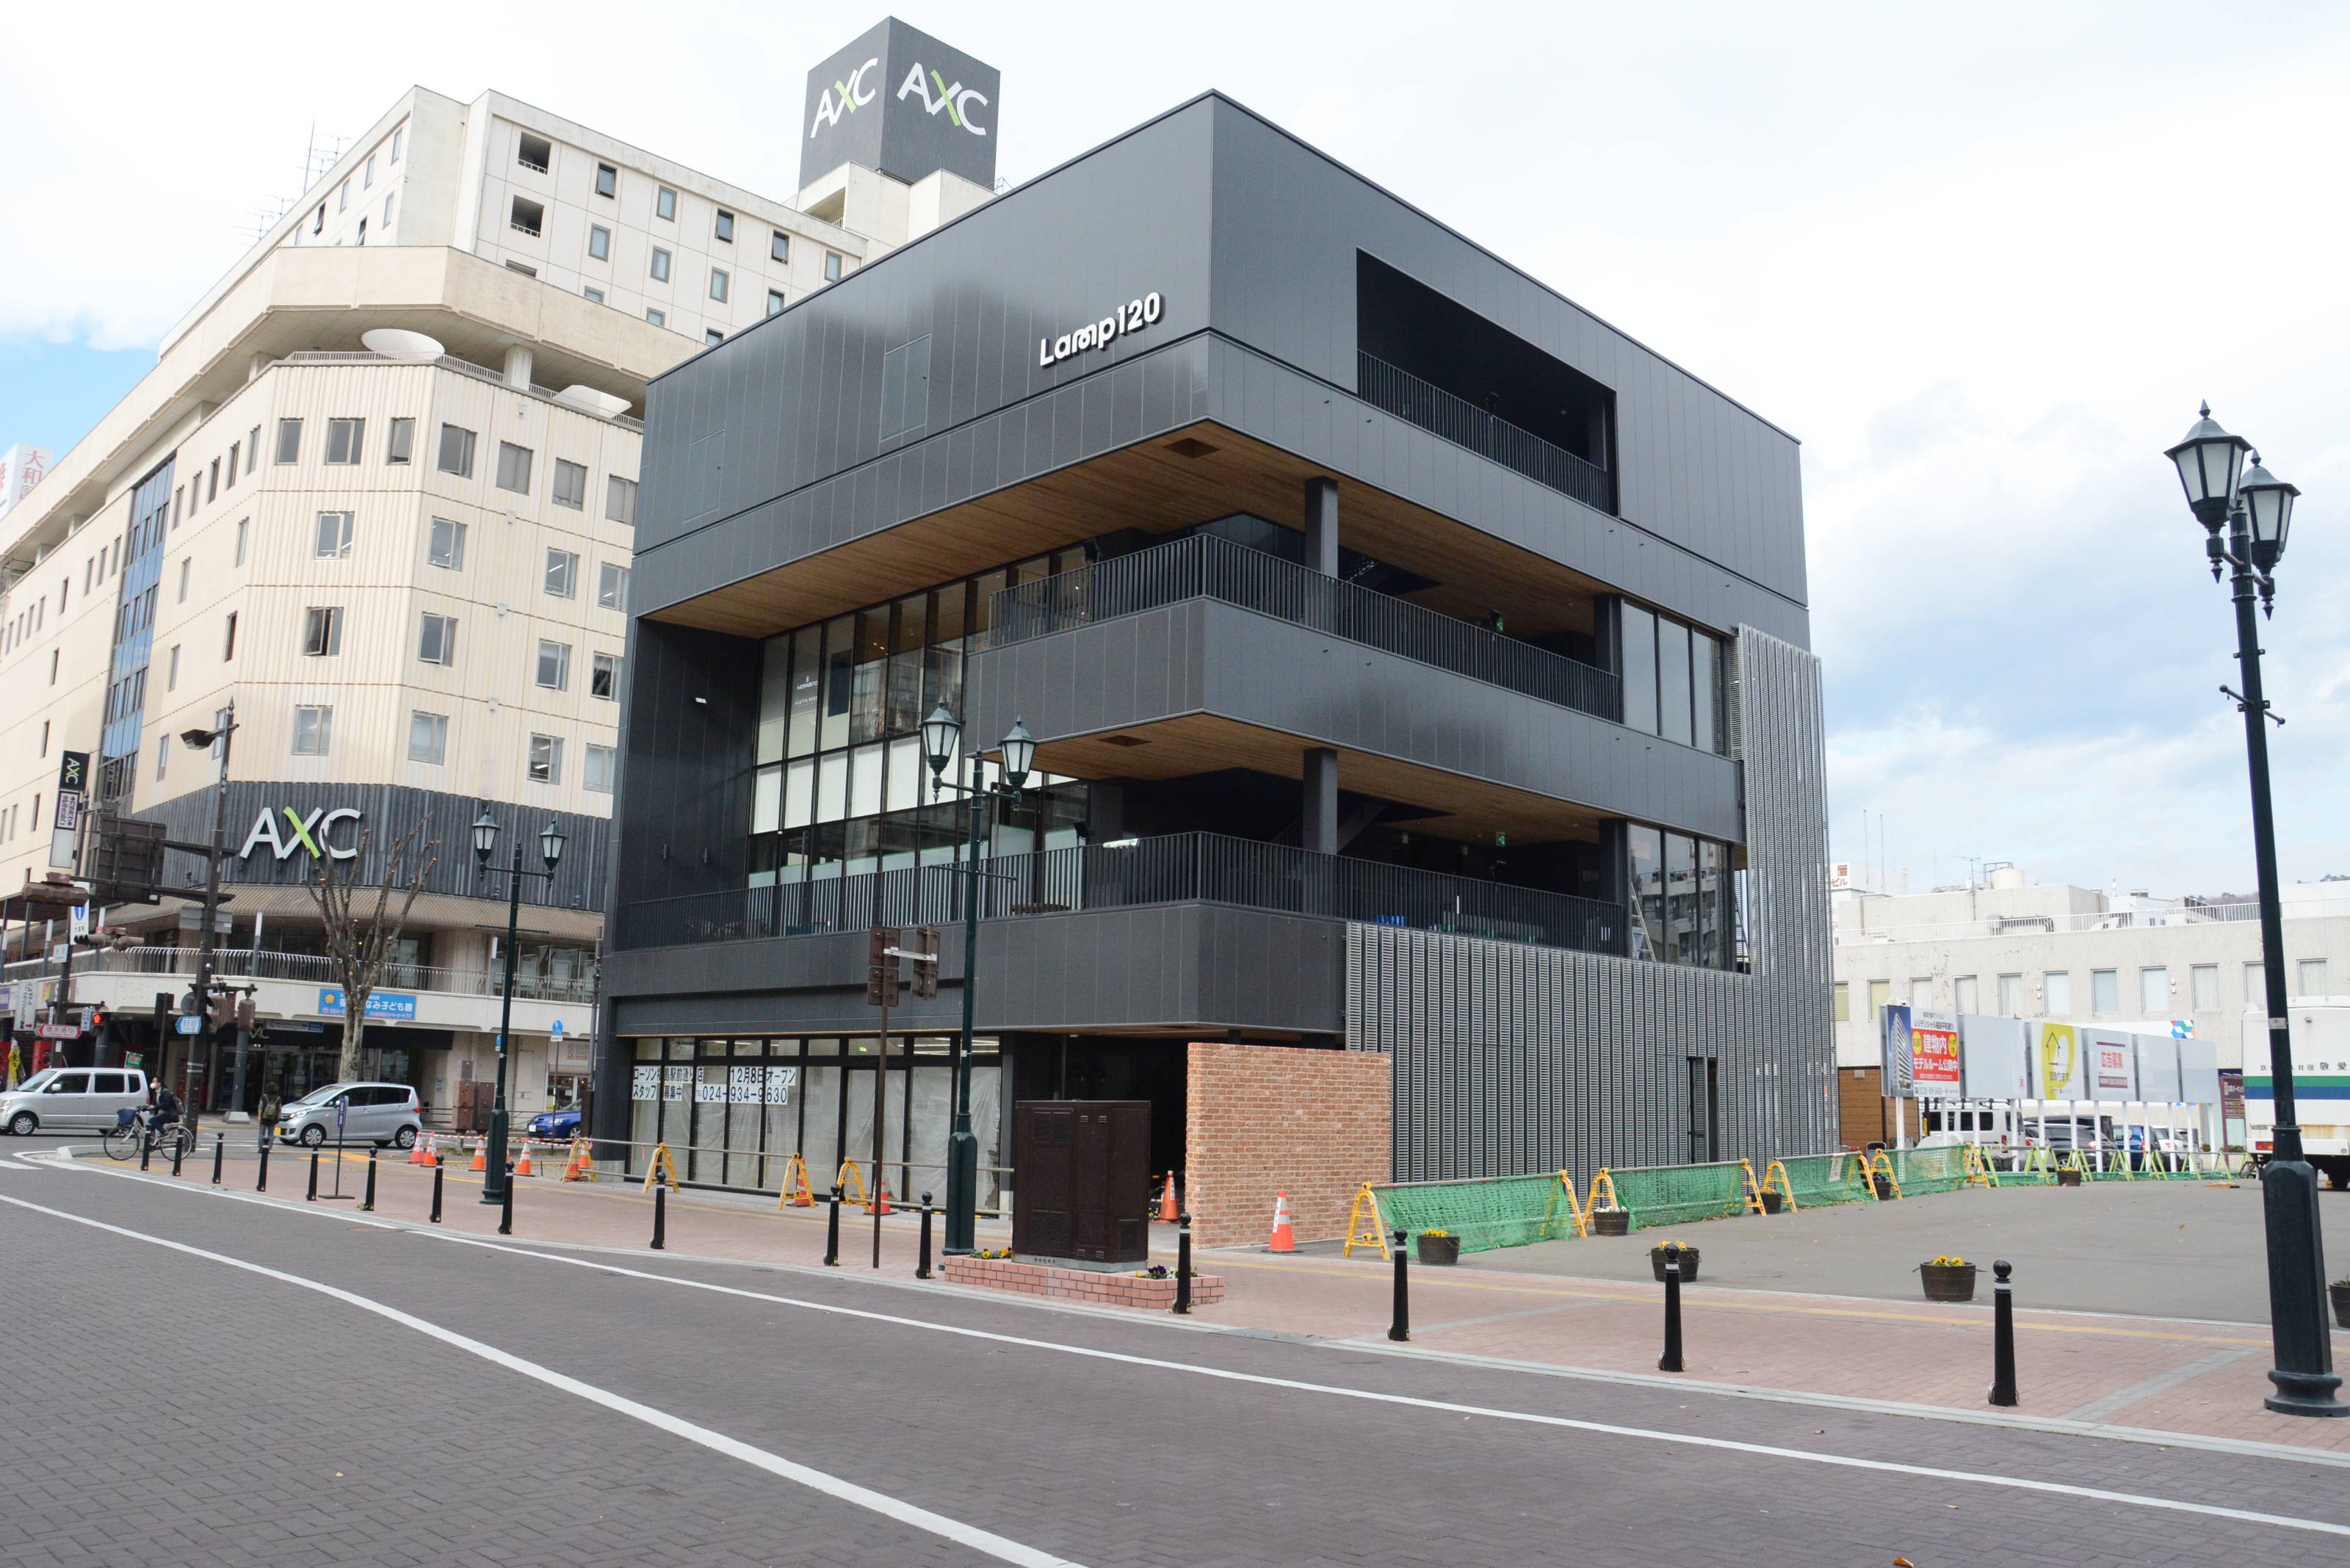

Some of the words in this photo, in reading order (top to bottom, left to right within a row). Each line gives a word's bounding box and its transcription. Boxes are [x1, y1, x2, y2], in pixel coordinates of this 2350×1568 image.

[810, 58, 878, 139] AXC
[897, 62, 988, 136] AXC
[65, 757, 81, 784] AXC
[239, 806, 363, 859] AXC
[1923, 1033, 1947, 1055] 建物内
